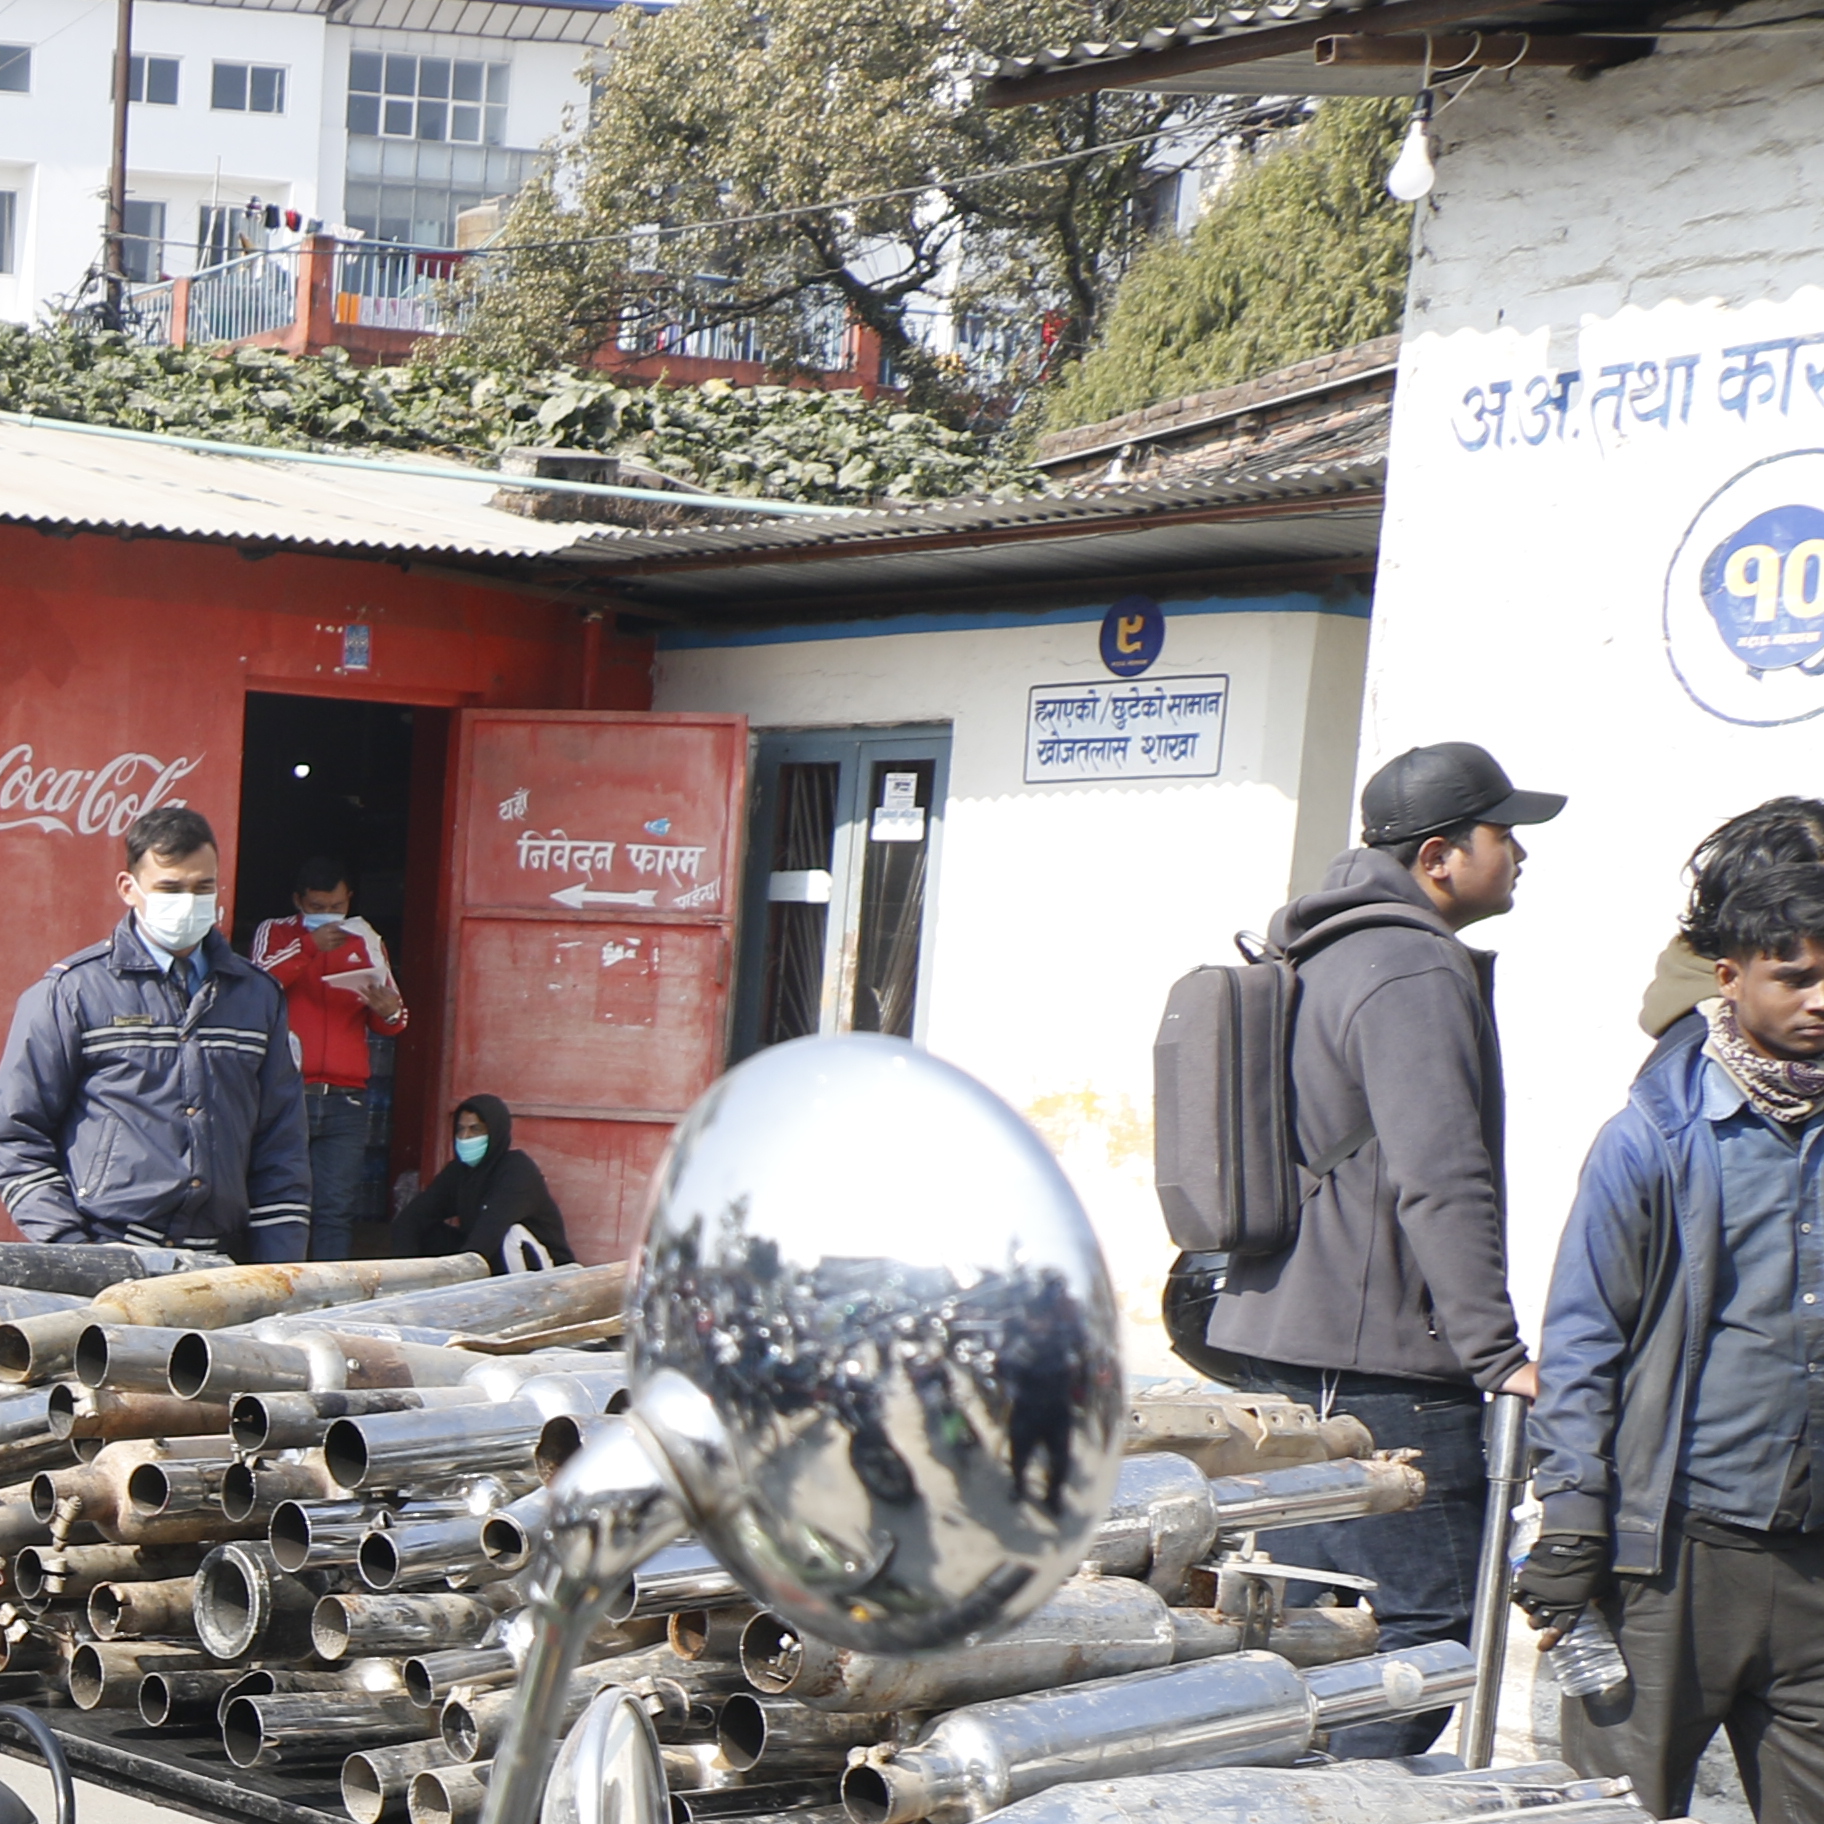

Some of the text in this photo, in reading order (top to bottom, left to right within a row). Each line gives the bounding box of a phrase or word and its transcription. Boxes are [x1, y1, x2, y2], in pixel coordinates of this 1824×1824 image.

[1167, 691, 1223, 726] सामान
[1141, 733, 1200, 764] शाखा
[517, 829, 707, 889] निवेदन फारम
